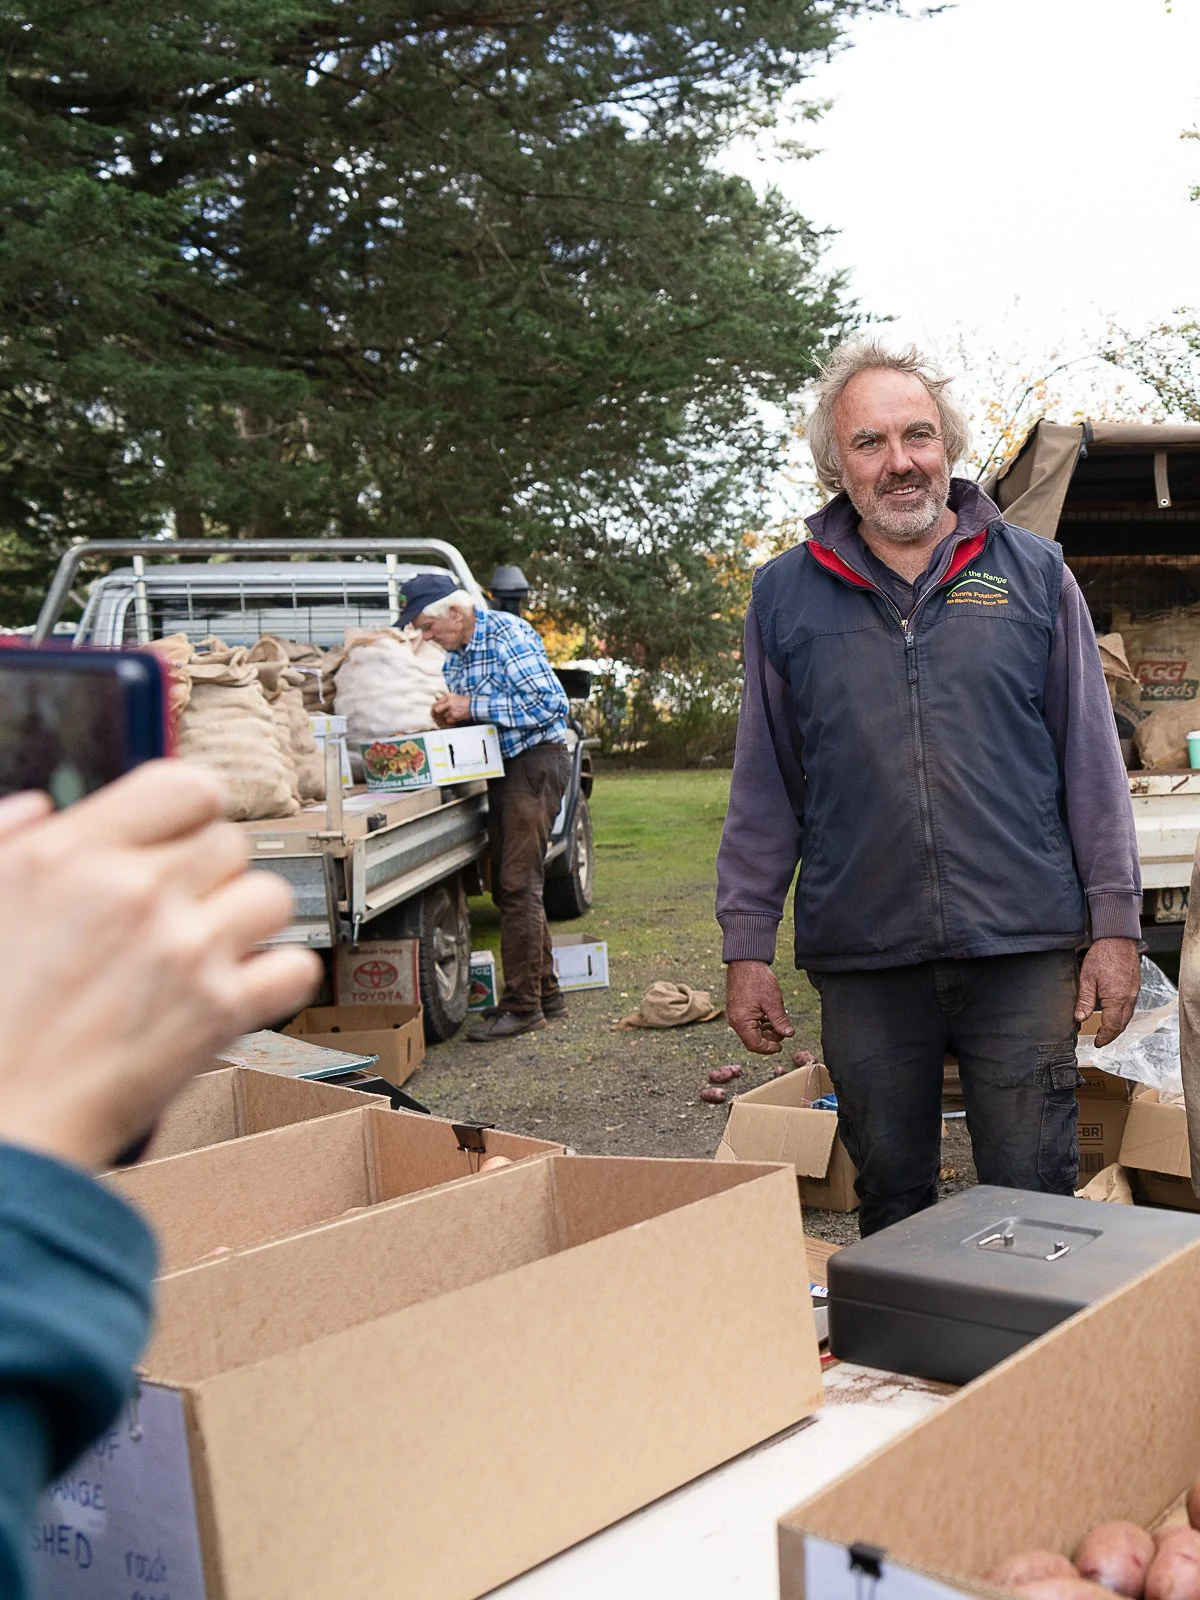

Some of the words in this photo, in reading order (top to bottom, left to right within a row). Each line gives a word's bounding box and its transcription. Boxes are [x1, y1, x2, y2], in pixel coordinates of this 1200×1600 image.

[968, 570, 982, 578] the
[983, 572, 1008, 584] Range
[974, 591, 1002, 599] Potatoes
[1146, 681, 1194, 698] seeds
[351, 991, 403, 1002] TOYOTA
[54, 1479, 107, 1511] ANGE
